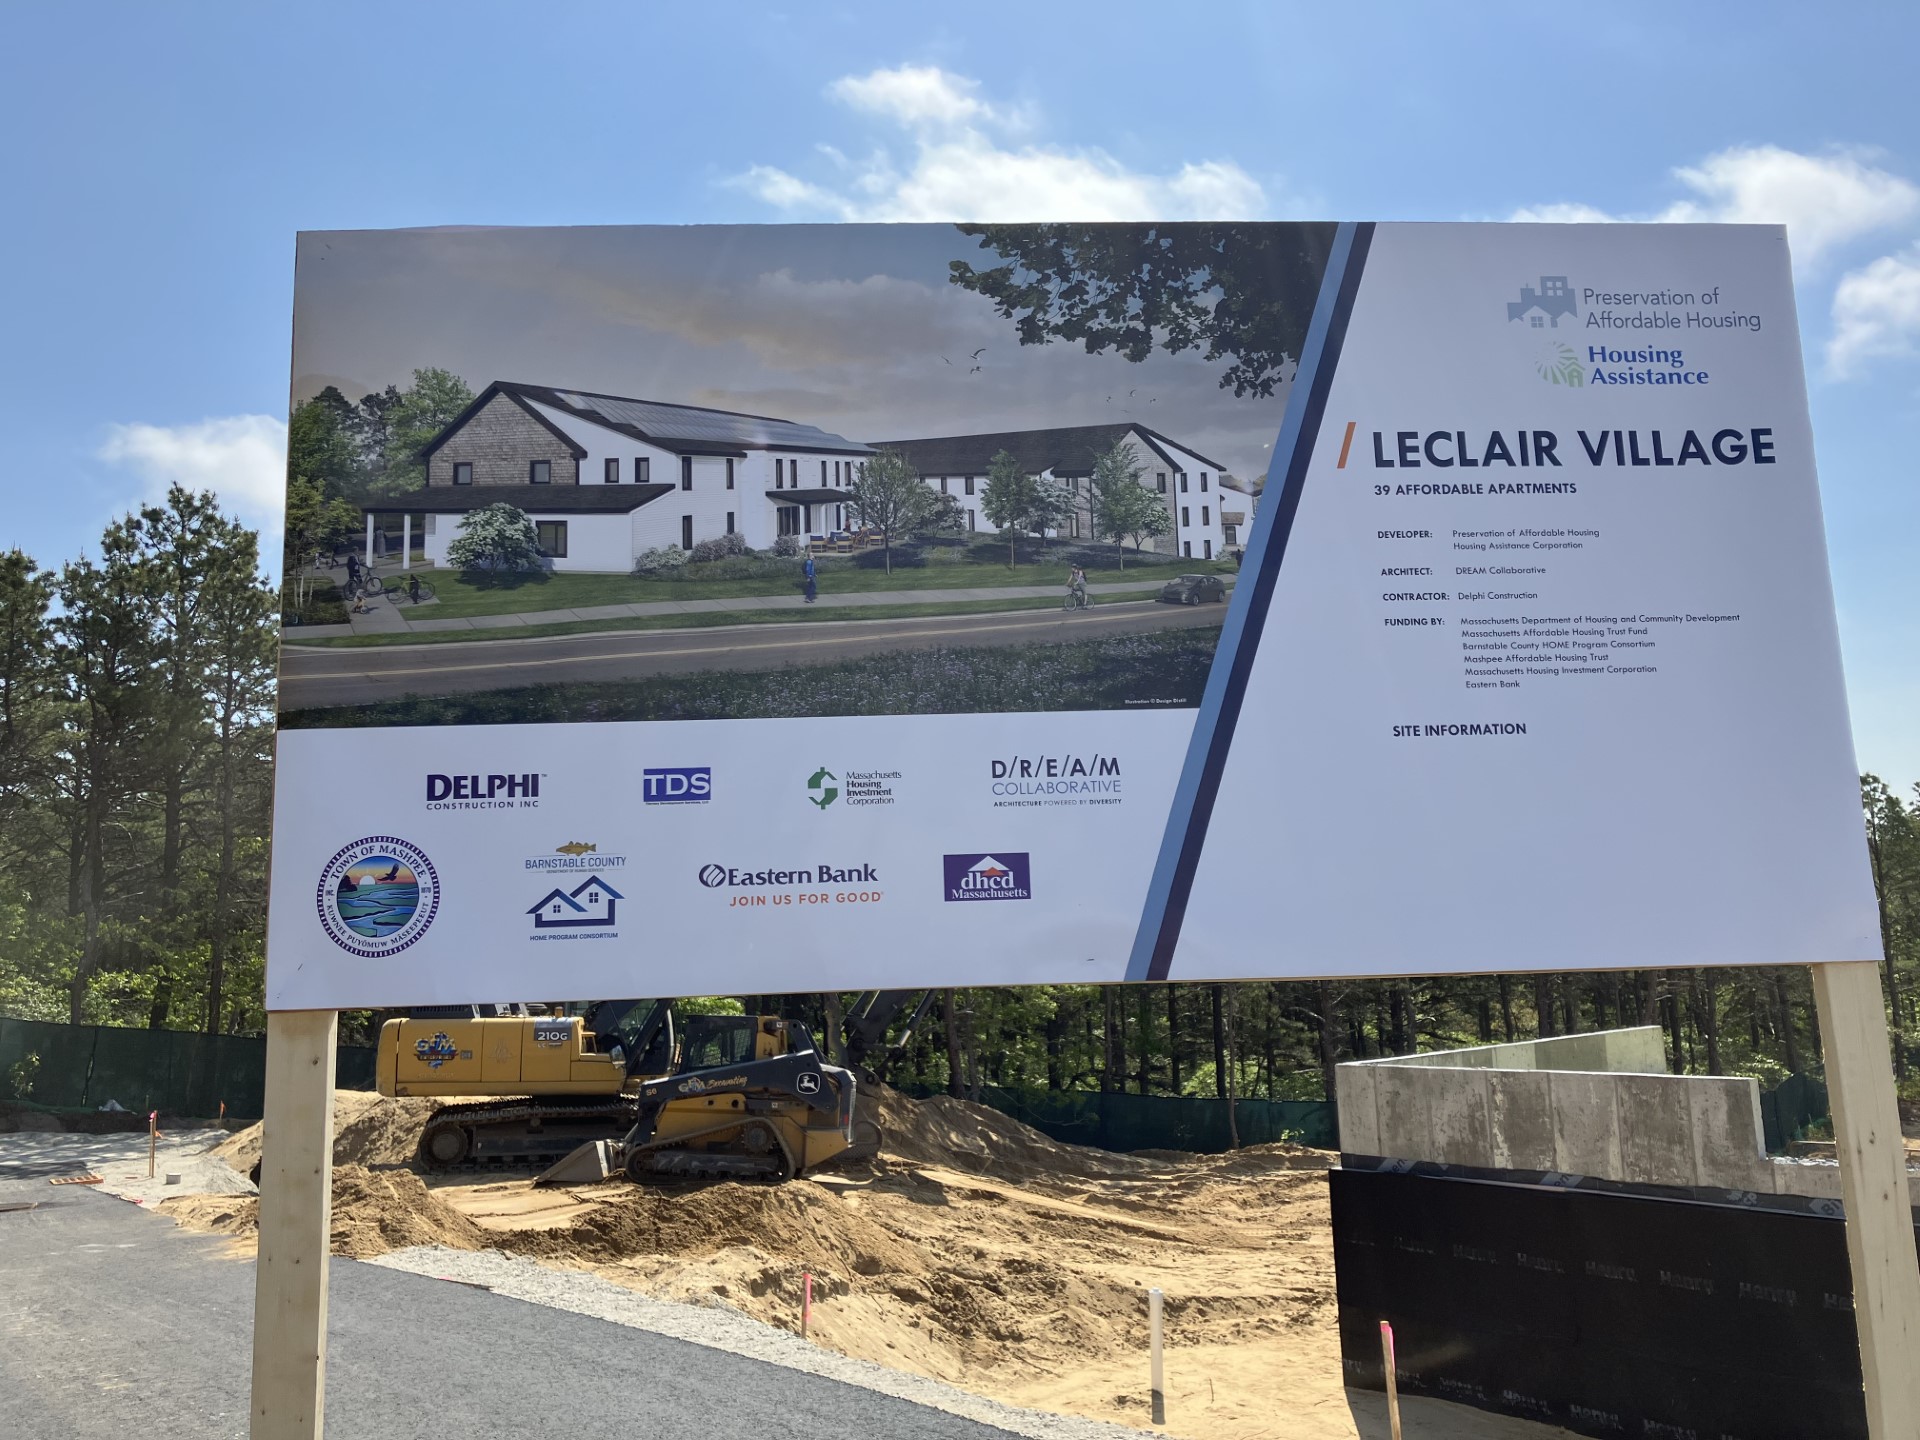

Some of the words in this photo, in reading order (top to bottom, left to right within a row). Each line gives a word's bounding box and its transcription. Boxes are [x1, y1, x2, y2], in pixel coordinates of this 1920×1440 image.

[1583, 287, 1694, 305] Preservation
[1701, 287, 1719, 305] of
[1586, 311, 1680, 329] Affordable
[1686, 311, 1761, 331] Housing
[1588, 345, 1684, 367] Housing
[1591, 368, 1709, 385] Assistance
[1373, 430, 1562, 468] LECLAIR
[1577, 428, 1776, 466] VILLAGE
[1374, 484, 1391, 496] 39
[1395, 484, 1483, 495] AFFORDABLE
[1487, 483, 1577, 494] APARTMENTS
[1452, 529, 1504, 537] Preservation
[1507, 529, 1516, 537] of
[1519, 528, 1565, 537] Affordable
[1567, 528, 1600, 538] Housing
[1453, 542, 1486, 551] Housing
[1489, 542, 1530, 550] Assistance
[1532, 541, 1583, 551] Corporation
[1381, 568, 1433, 576] ARCHITECT:
[1456, 567, 1486, 575] DREAM
[1489, 566, 1546, 574] Collaborative
[1383, 593, 1450, 601] CONTRACTOR:
[1458, 592, 1485, 602] Delphi
[1488, 591, 1538, 600] Construction
[1384, 618, 1428, 626] FUNDING
[1430, 617, 1445, 626] BY:
[1460, 617, 1519, 625] Massachusetts
[1522, 616, 1572, 626] Department
[1574, 615, 1582, 623] of
[1585, 615, 1618, 625] Housing
[1620, 615, 1636, 623] and
[1639, 614, 1683, 625] Community
[1686, 614, 1740, 624] Development
[1461, 629, 1520, 638] Massachusetts
[1523, 629, 1570, 637] Affordable
[1572, 628, 1604, 638] Housing
[1607, 628, 1626, 636] Trust
[1628, 627, 1648, 636] Fund
[1462, 642, 1508, 650] Barnstable
[1510, 641, 1540, 652] County
[1542, 641, 1570, 649] HOME
[1572, 641, 1608, 651] Program
[1610, 640, 1656, 648] Consortium
[1464, 655, 1503, 664] Mashpee
[1505, 654, 1552, 663] Affordable
[1555, 654, 1587, 664] Housing
[1590, 653, 1609, 662] Trust
[1465, 667, 1524, 675] Massachusetts
[1526, 666, 1559, 676] Housing
[1562, 666, 1604, 674] Investment
[1607, 665, 1657, 675] Corporation
[1466, 680, 1497, 689] Eastern
[1500, 680, 1520, 688] Bank
[1393, 725, 1421, 737] SITE
[1424, 723, 1526, 736] INFORMATION
[846, 770, 902, 779] Massachusetts
[427, 774, 539, 801] DELPHI
[645, 773, 710, 796] TDS
[846, 779, 882, 789] Housing
[992, 780, 1122, 796] COLLABORATIVE
[846, 787, 892, 797] Investment
[427, 802, 514, 810] CONSTRUCTION
[847, 796, 894, 806] Corporation
[330, 851, 359, 880] TOWN
[361, 845, 376, 856] OF
[379, 845, 426, 878] MASHPEE
[525, 858, 586, 869] BARNSTABLE
[588, 856, 626, 867] COUNTY
[728, 867, 813, 887] Eastern
[818, 863, 878, 883] Bank
[960, 871, 1015, 890] dhcd
[729, 894, 768, 907] JOIN
[773, 893, 792, 905] US
[799, 892, 830, 904] FOR
[836, 891, 881, 903] GOOD
[952, 887, 1028, 900] Massachusetts
[538, 1031, 568, 1040] 210G
